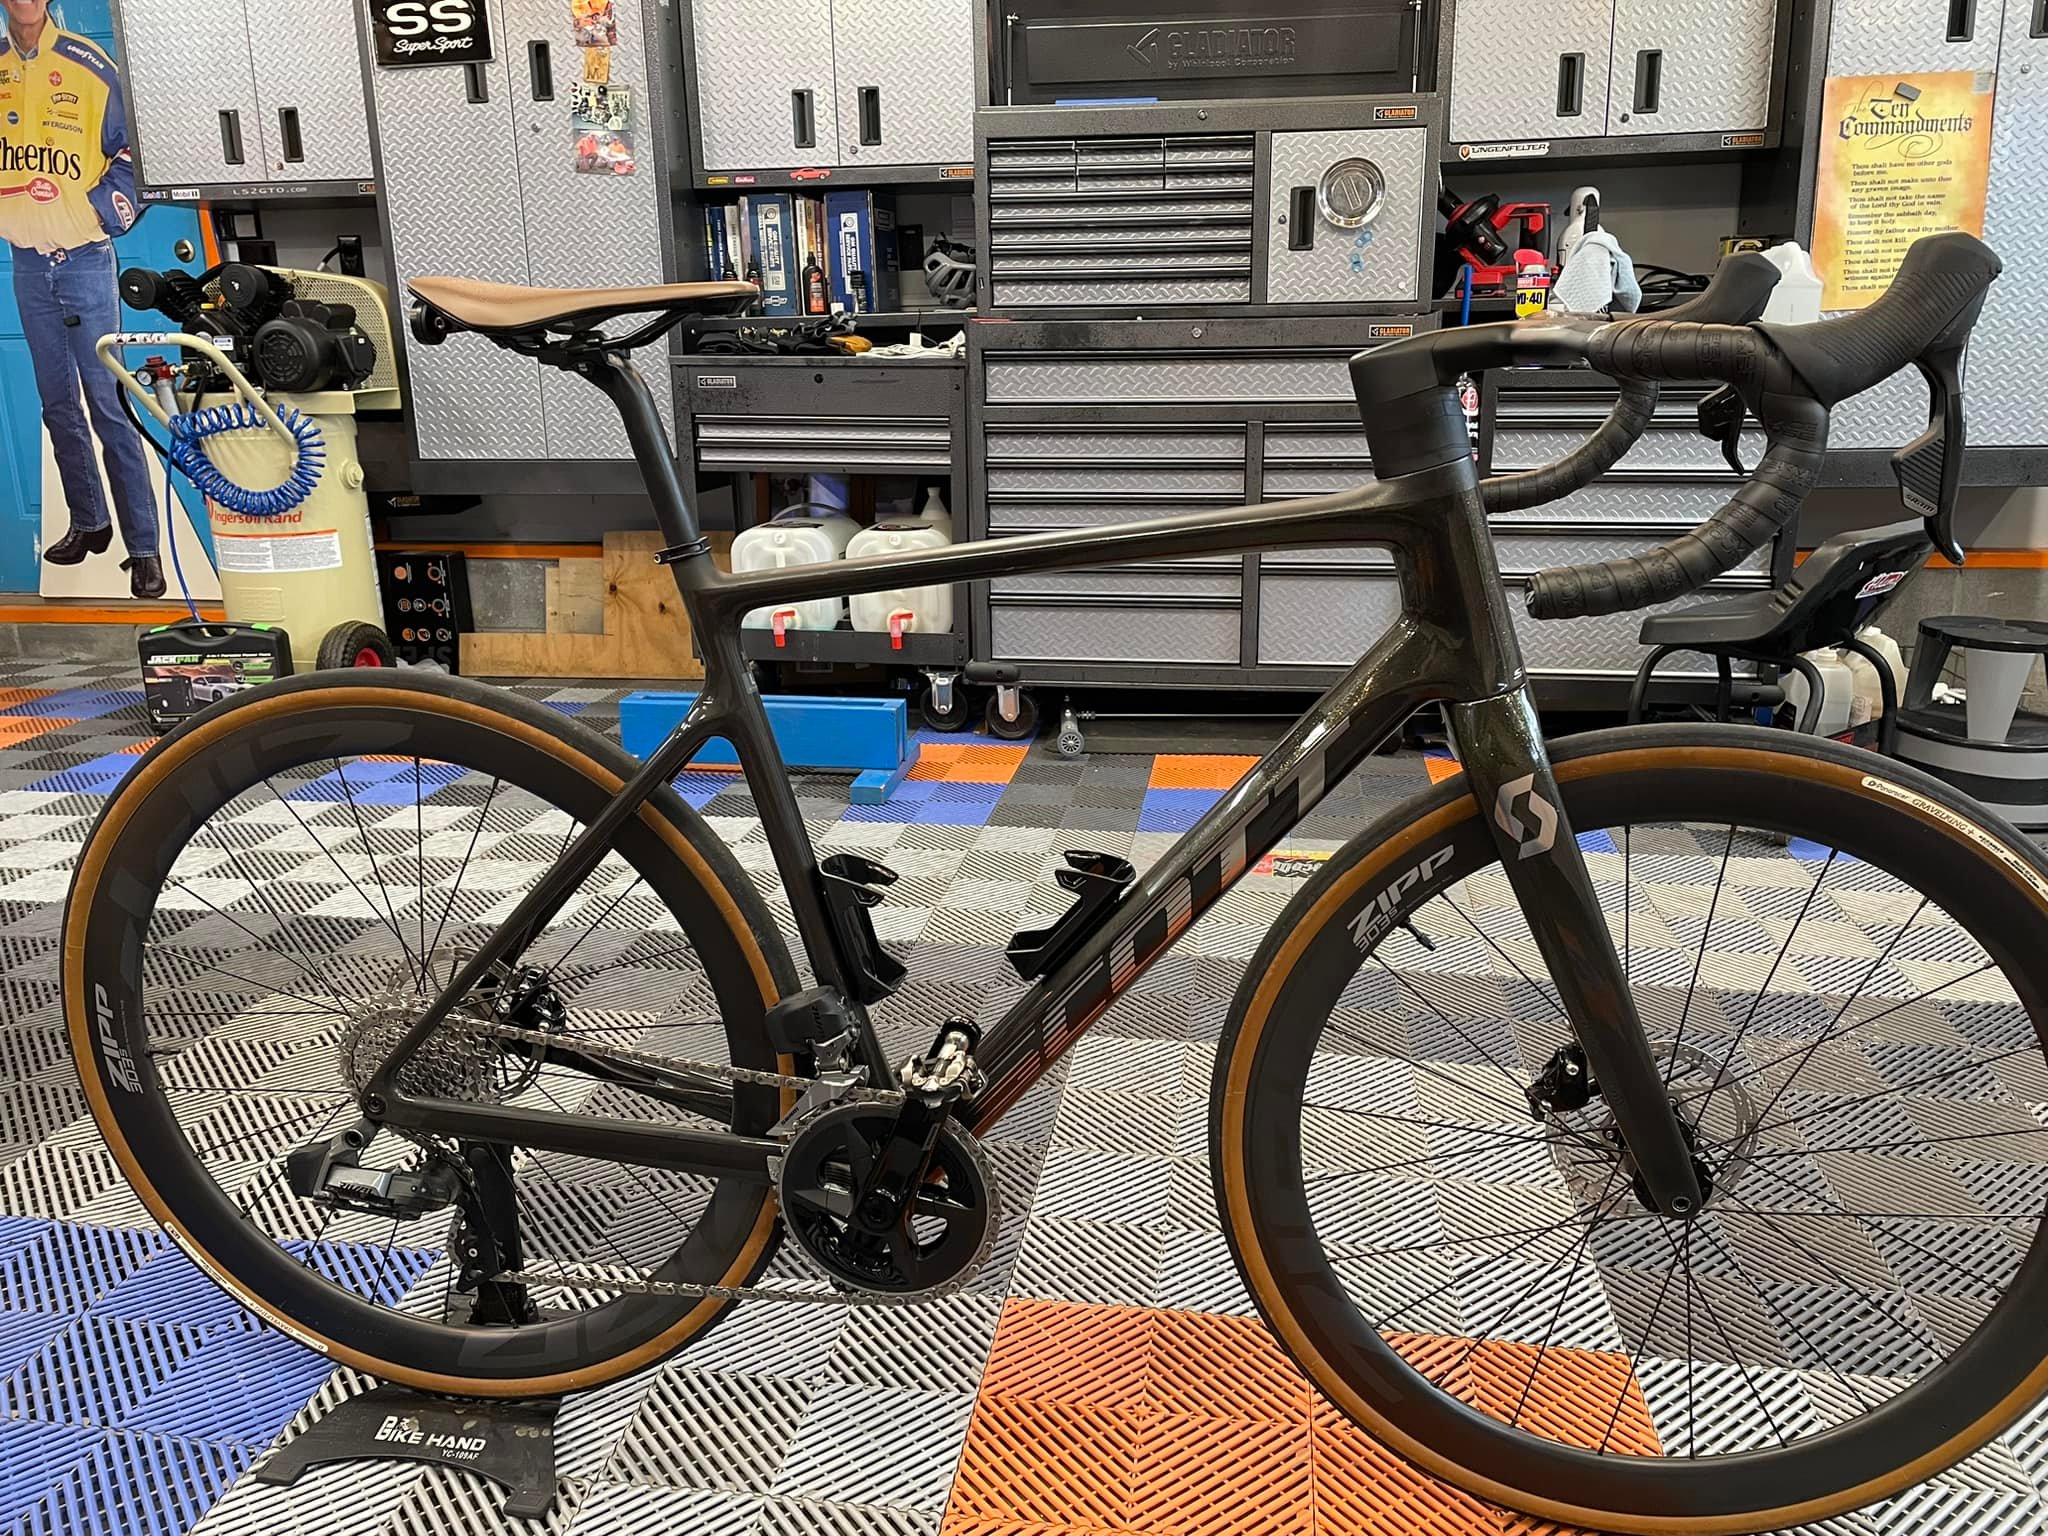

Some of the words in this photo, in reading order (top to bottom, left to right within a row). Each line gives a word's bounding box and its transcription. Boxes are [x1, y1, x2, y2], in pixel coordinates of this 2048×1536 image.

[386, 0, 472, 36] SS
[393, 38, 432, 56] Super
[432, 36, 473, 54] Sport
[1167, 27, 1296, 58] GLADIATOR
[1838, 108, 1973, 140] Commandments
[1869, 98, 1909, 120] Ten
[1911, 797, 1968, 831] GRAVELKING
[1346, 844, 1455, 944] ZIPP
[94, 982, 132, 1093] ZIPP
[374, 1415, 425, 1445] BIKE
[425, 1433, 487, 1451] HAND
